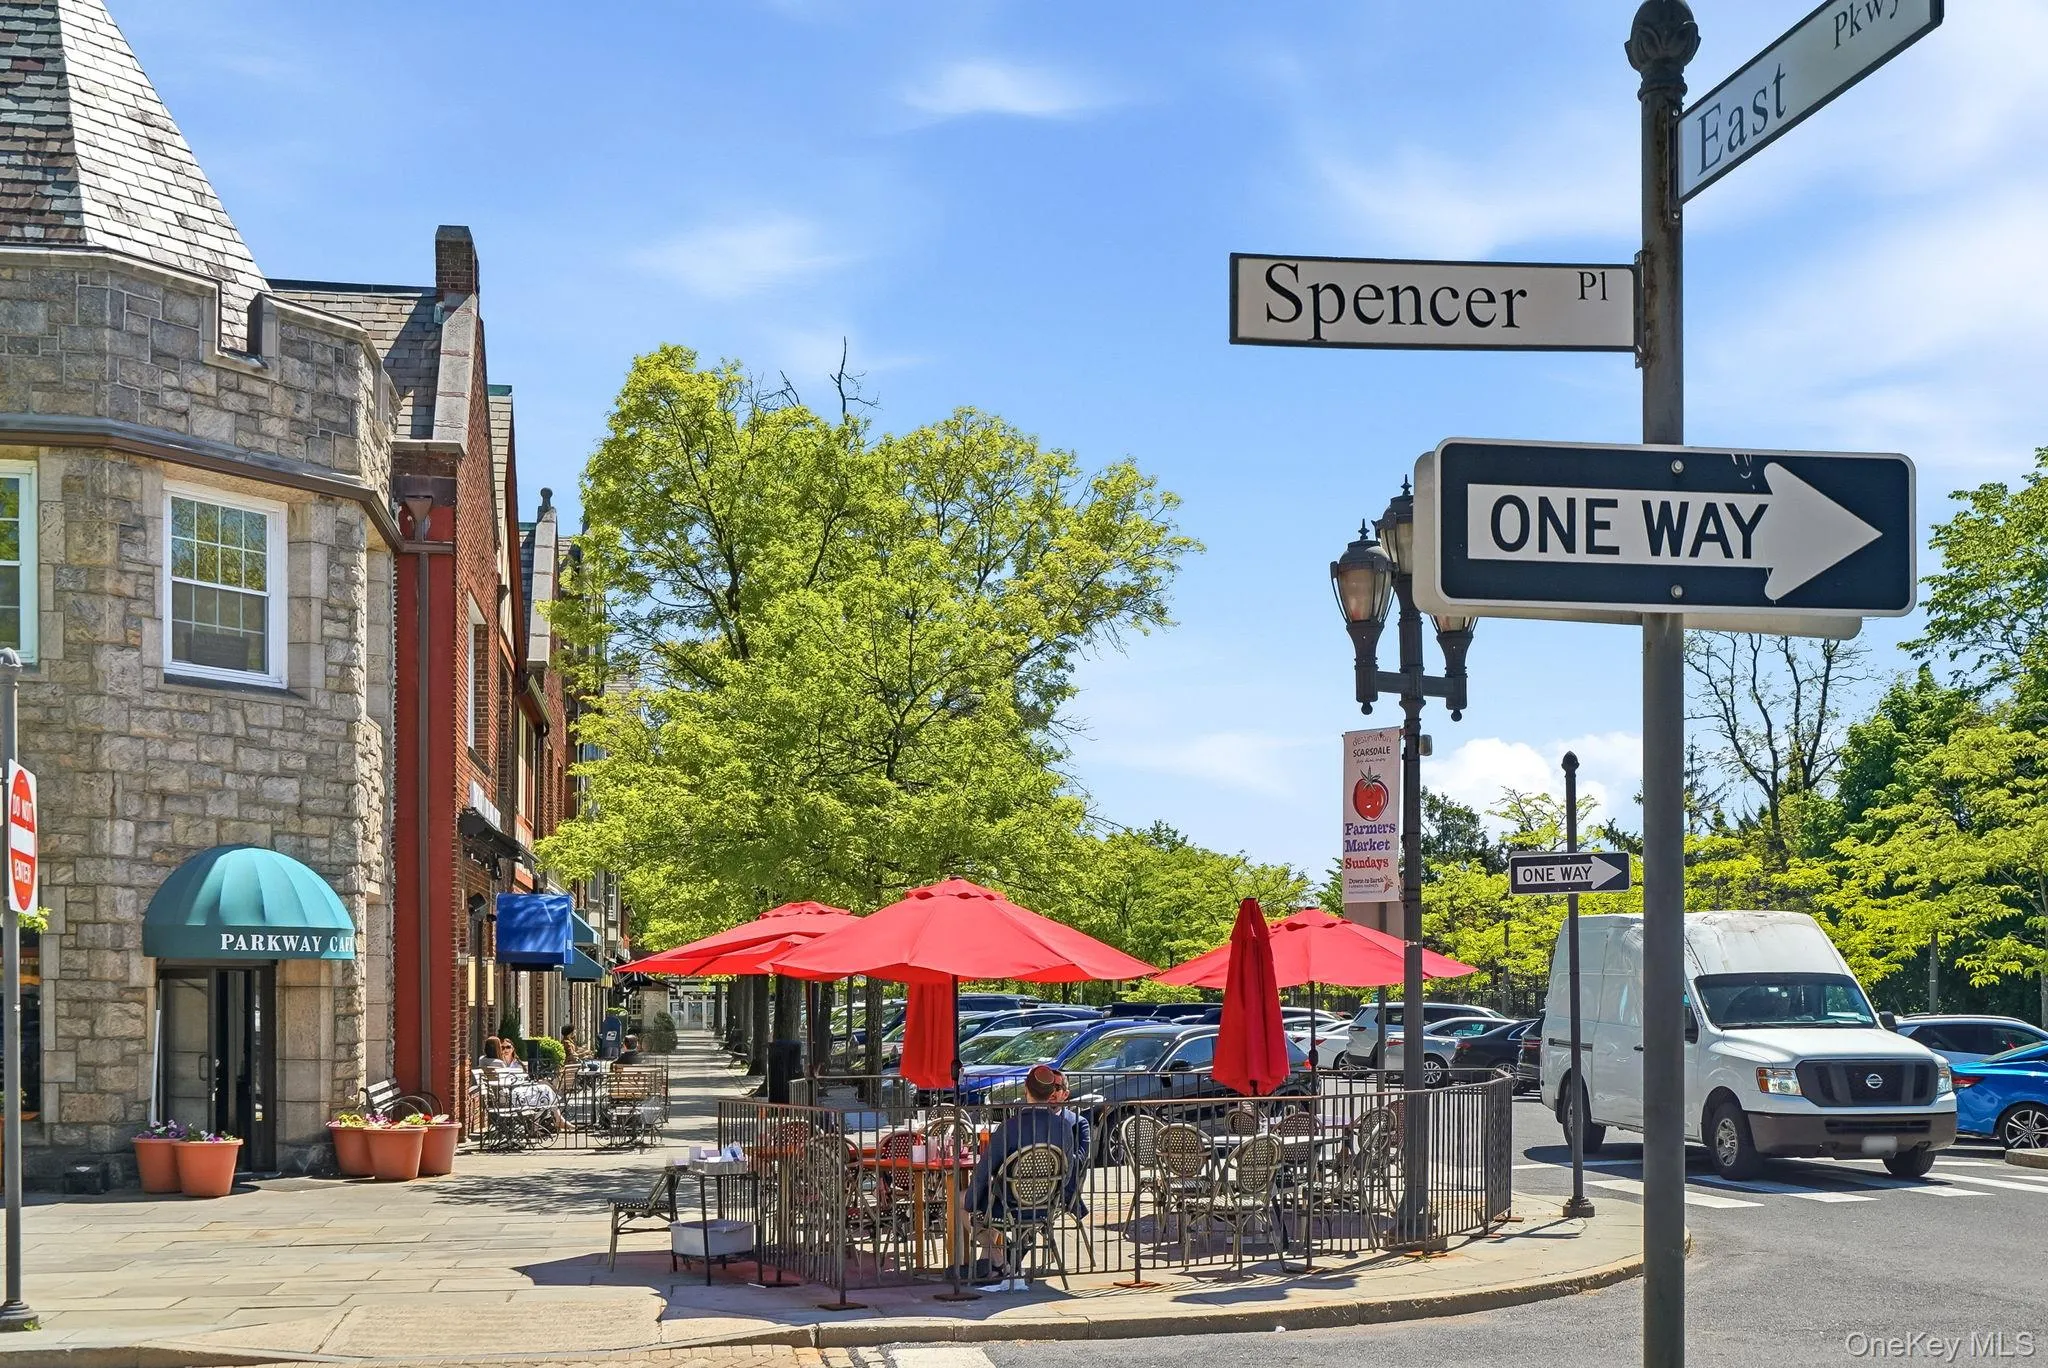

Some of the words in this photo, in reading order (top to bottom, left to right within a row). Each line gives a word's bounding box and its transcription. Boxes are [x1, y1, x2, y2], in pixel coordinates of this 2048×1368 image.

[1697, 62, 1787, 177] East
[1265, 262, 1528, 341] Spencer
[1577, 270, 1608, 301] Pl
[1490, 494, 1620, 556] ONE
[1641, 499, 1769, 559] WAY
[1352, 746, 1391, 757] SCARSDALE
[12, 793, 21, 817] DO
[21, 799, 33, 823] NOT
[1345, 822, 1396, 835] Farmers
[1344, 838, 1391, 853] Market
[14, 858, 32, 885] ENTER
[1345, 856, 1389, 871] Sundays
[1522, 867, 1556, 882] ONE
[1560, 865, 1592, 881] WAY
[220, 933, 322, 952] PARKWAY
